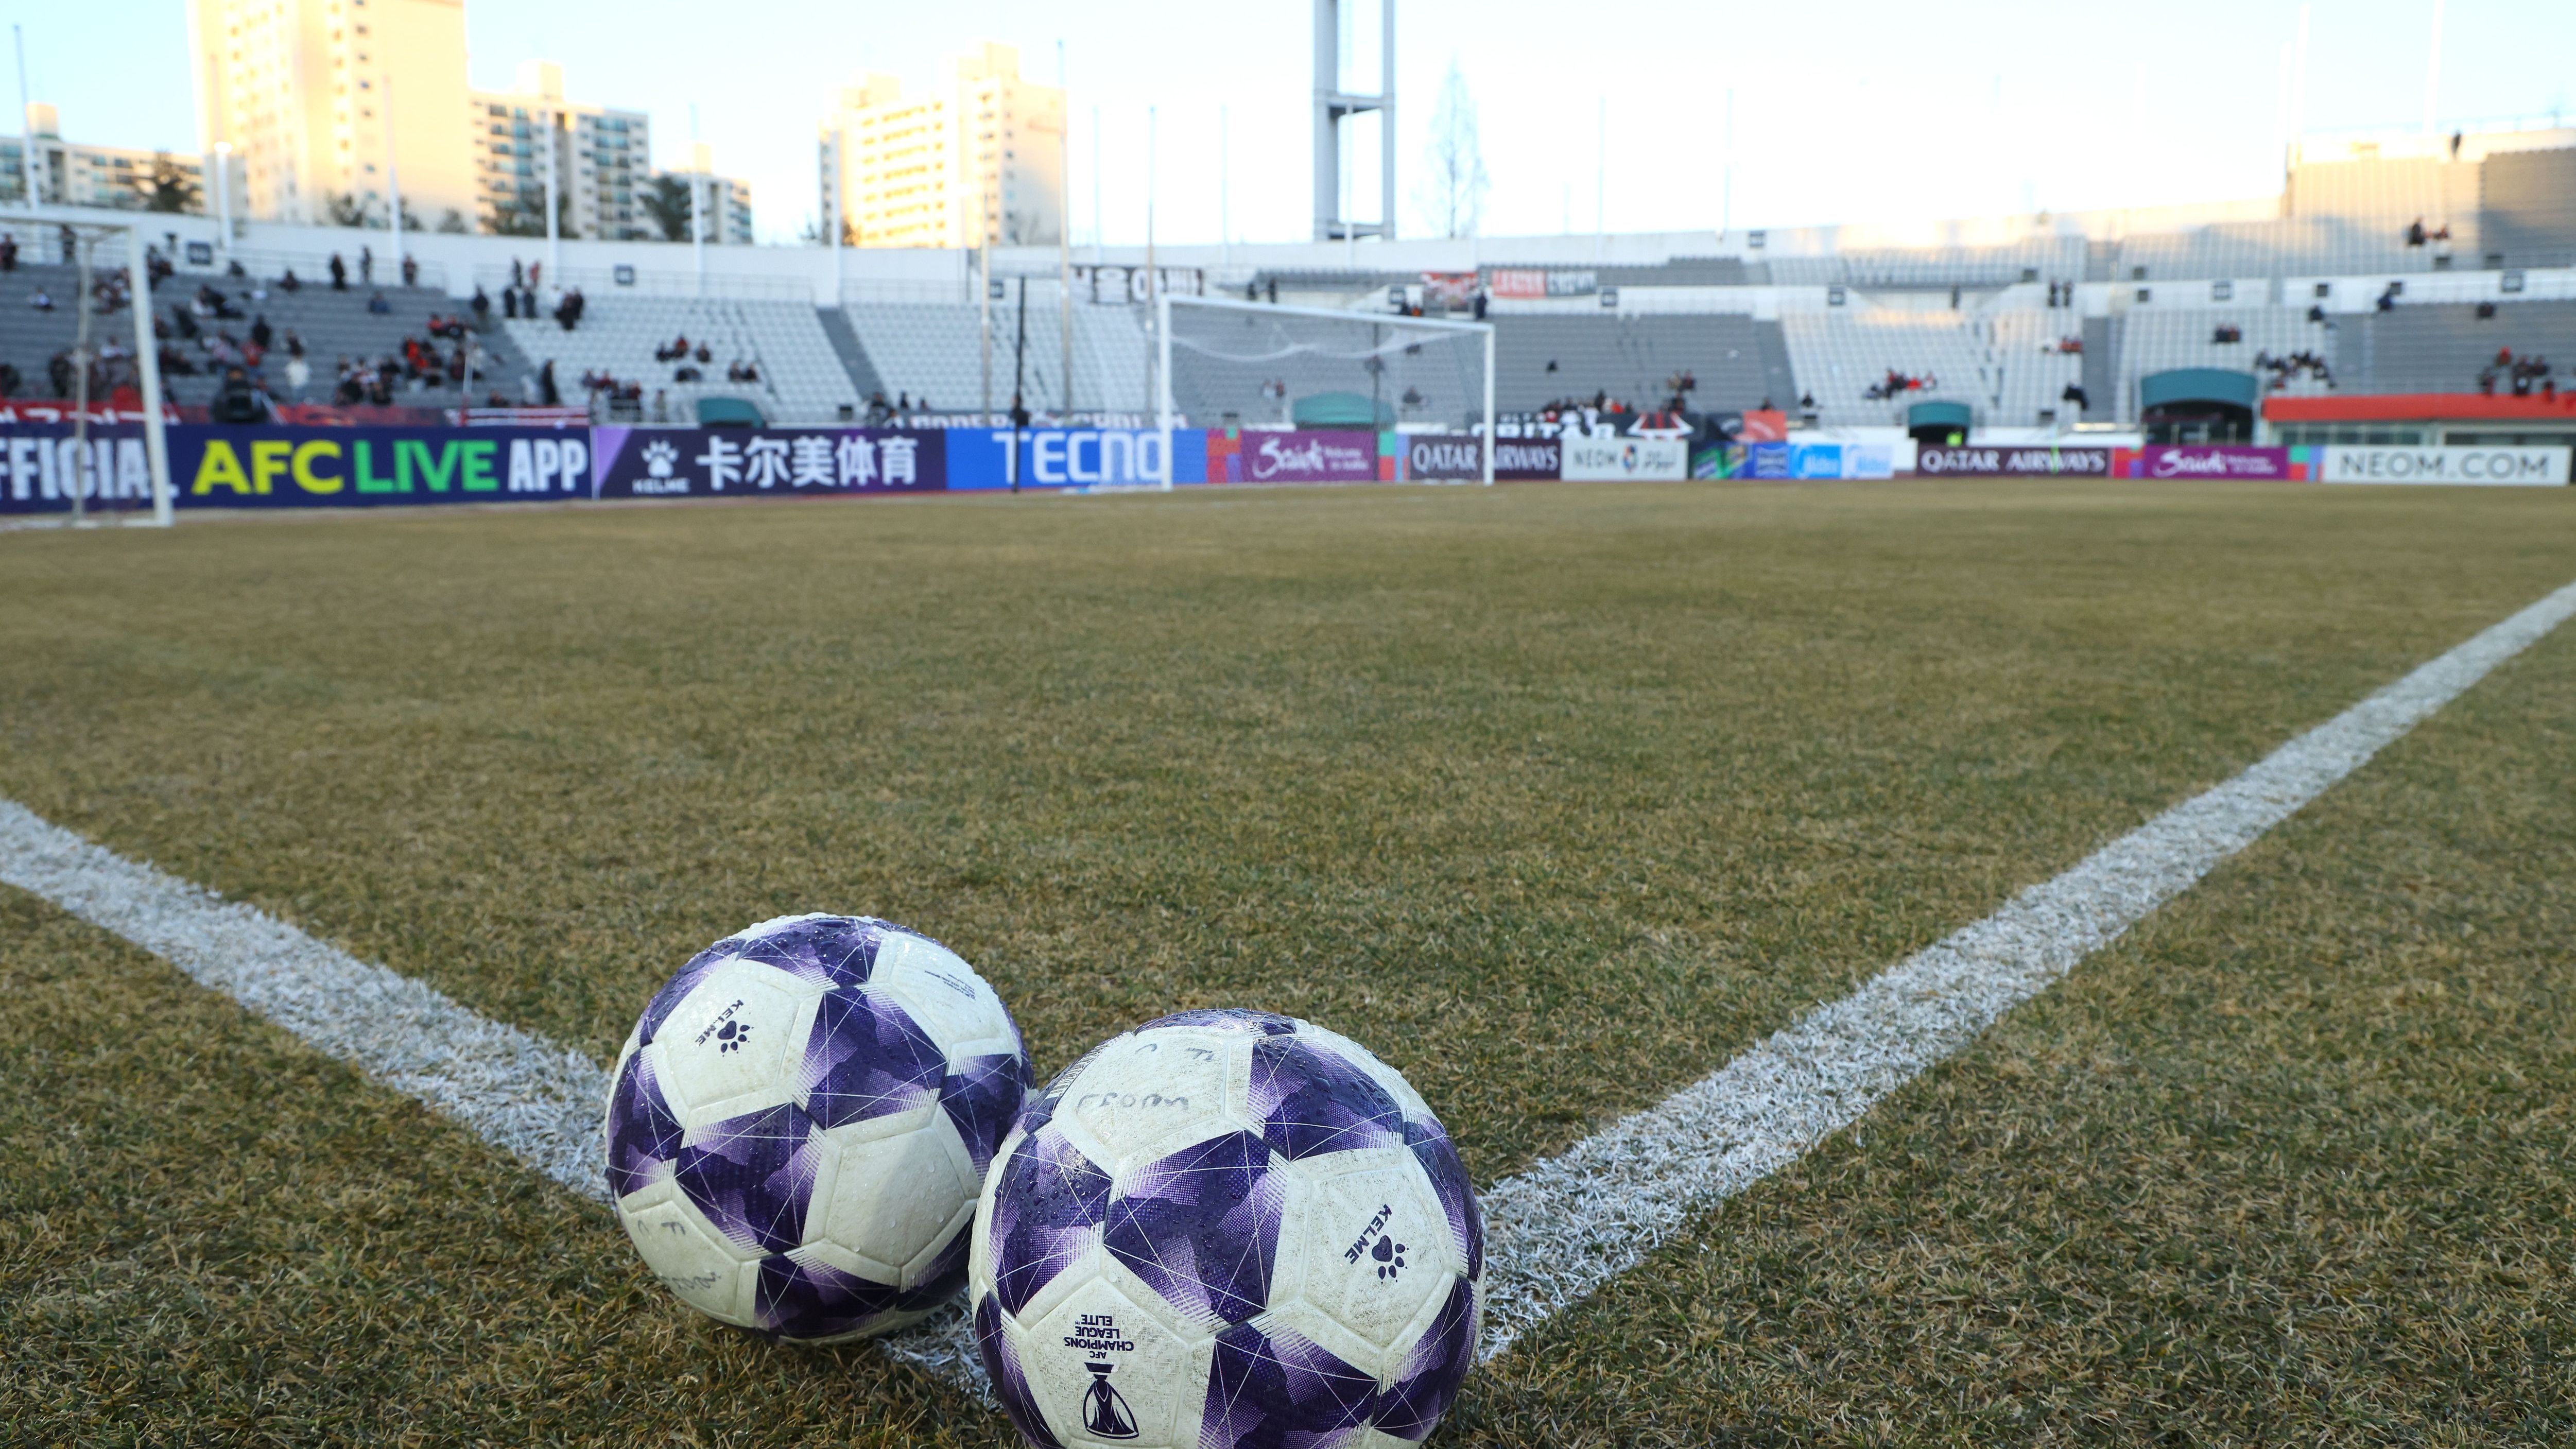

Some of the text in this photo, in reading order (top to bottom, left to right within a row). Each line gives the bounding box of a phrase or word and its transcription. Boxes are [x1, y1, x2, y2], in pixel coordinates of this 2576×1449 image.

[0, 437, 588, 500] FICIA AFC LIVE APP
[695, 435, 918, 491] 卡尔美体育
[992, 430, 1166, 485] TECNO
[1412, 442, 1478, 473] QATAR
[1921, 449, 2000, 473] QATAR
[2006, 449, 2106, 473] AIRWAYS
[2339, 451, 2550, 479] NEOM.COM
[632, 477, 691, 494] KELME
[695, 999, 744, 1047] KELME
[1344, 1203, 1392, 1265] KELME
[1064, 1337, 1134, 1352] CHAMPIONS
[1075, 1326, 1120, 1339] LEAGUE
[1089, 1351, 1107, 1359] AFC
